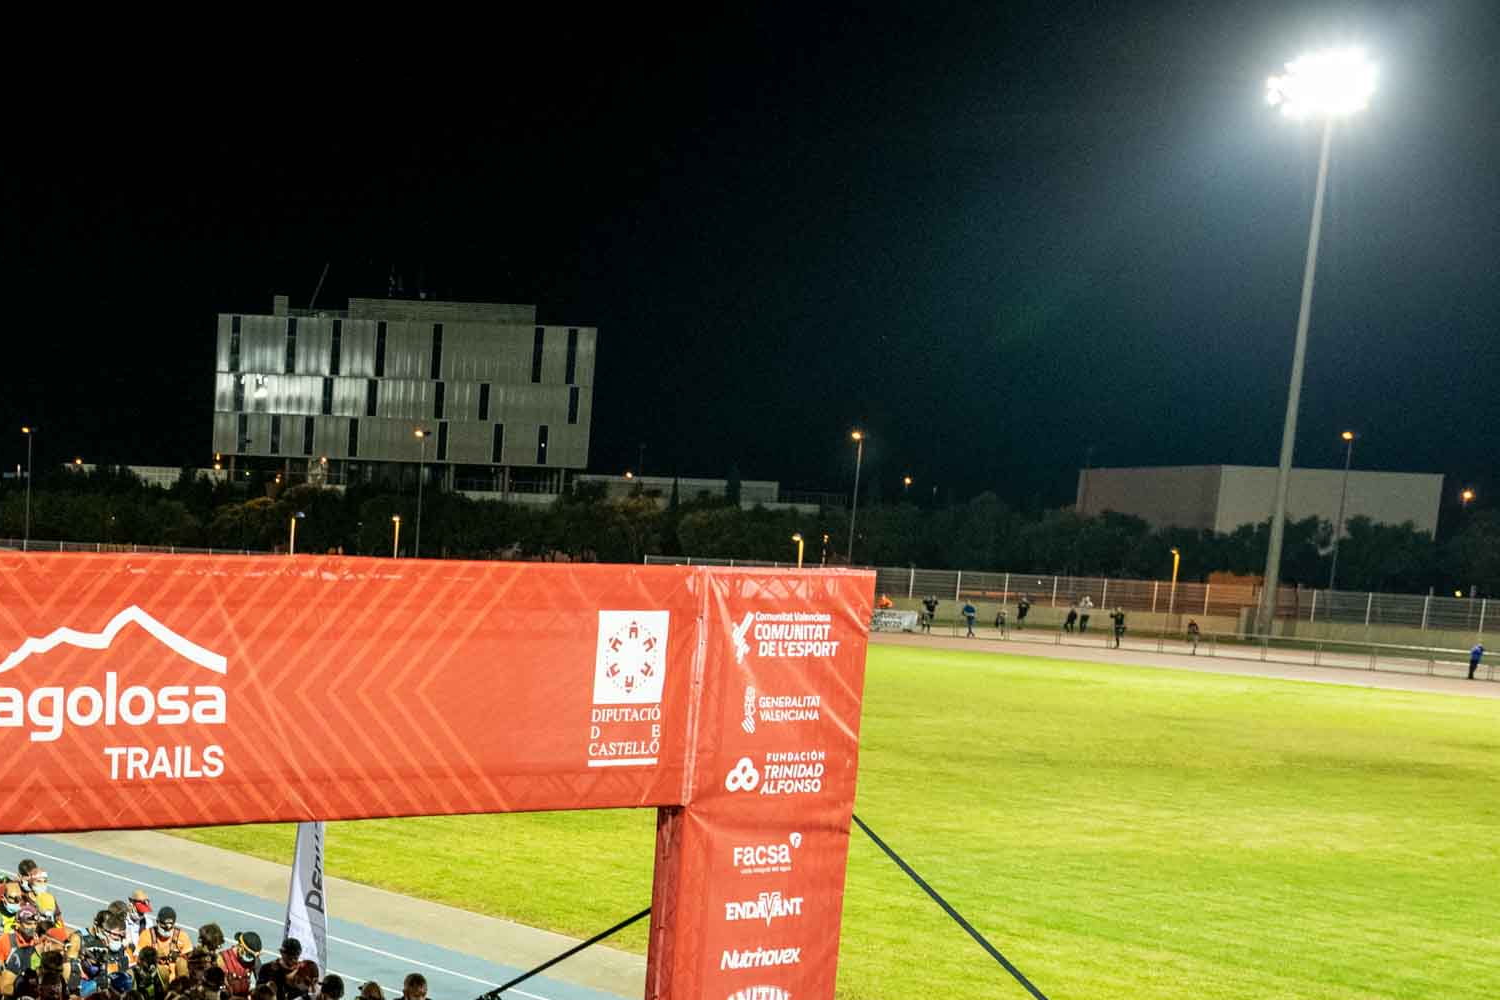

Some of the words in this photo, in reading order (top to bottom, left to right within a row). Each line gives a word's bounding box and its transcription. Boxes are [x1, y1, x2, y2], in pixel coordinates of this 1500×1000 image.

[754, 624, 830, 640] COMUNITAT
[759, 641, 776, 656] DE
[778, 641, 839, 656] L'ESPORT
[758, 696, 821, 708] GENERALITAT
[591, 704, 661, 722] DIPUTACIÓ
[759, 709, 820, 722] VALENCIANA
[588, 739, 660, 757] CASTELLÓ
[766, 750, 825, 762] FUNDACIÓN
[104, 744, 224, 780] TRAILS
[764, 763, 824, 779] TRINIDAD
[760, 779, 821, 795] ALFONSO
[725, 891, 803, 927] ENDAVANT
[721, 947, 801, 970] Nutrinovex
